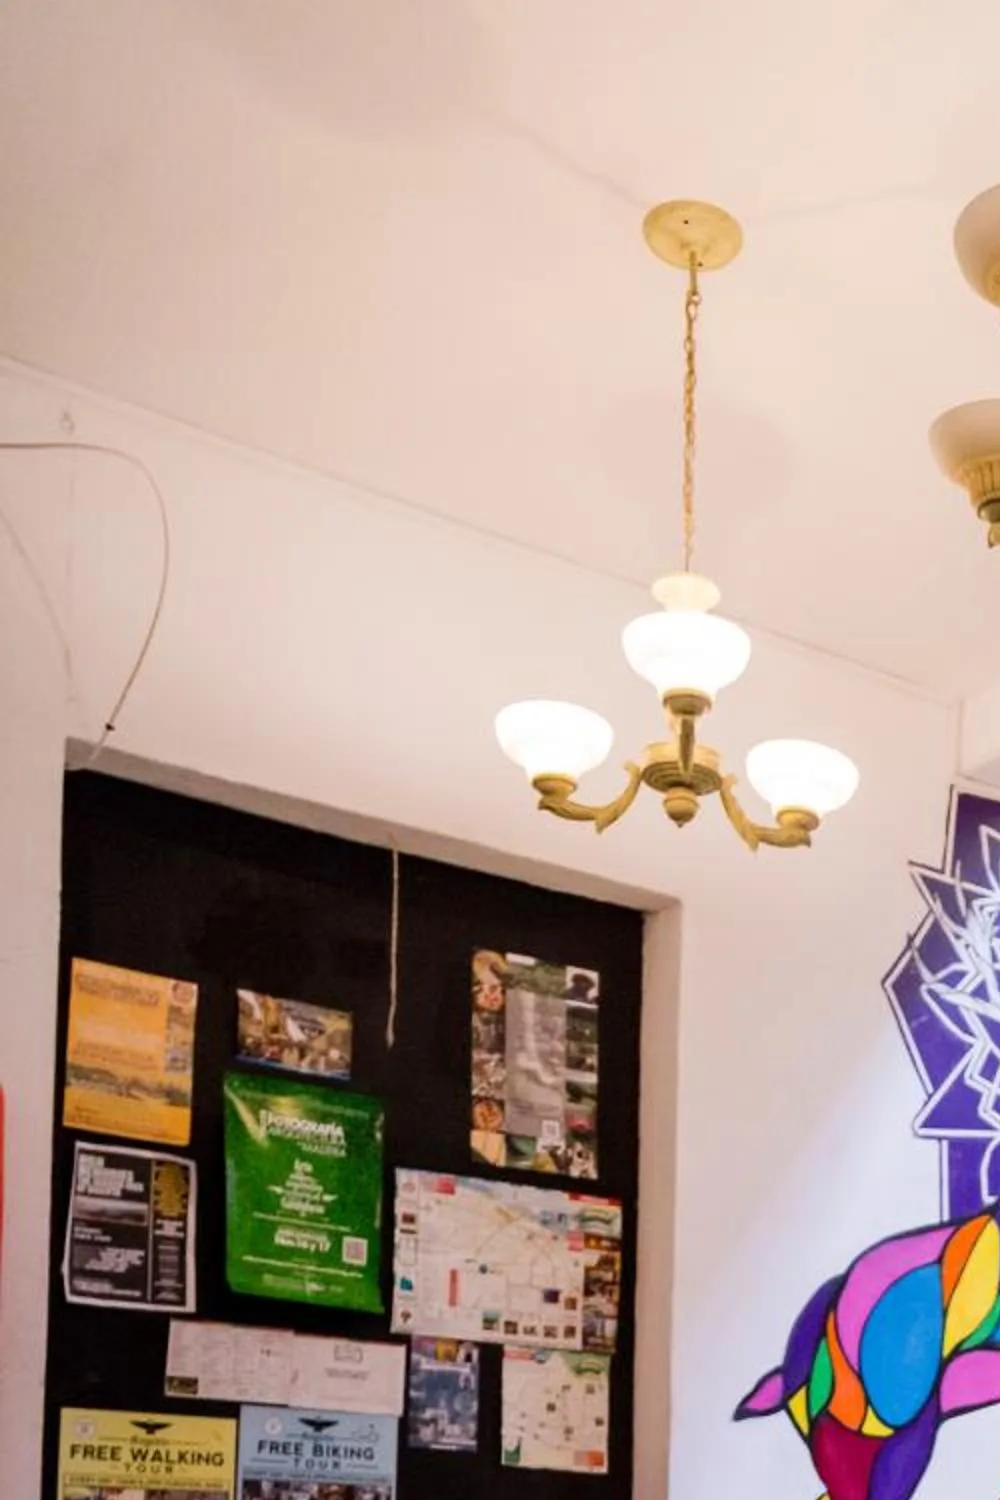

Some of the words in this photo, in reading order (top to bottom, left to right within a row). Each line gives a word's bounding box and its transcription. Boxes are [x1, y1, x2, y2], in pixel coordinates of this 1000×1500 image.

[69, 1443, 122, 1462] FREE
[130, 1446, 225, 1468] WALKING
[257, 1439, 304, 1456] FREE
[312, 1442, 376, 1461] BIKING
[124, 1462, 174, 1475] TOUR
[293, 1457, 342, 1471] TOUR
